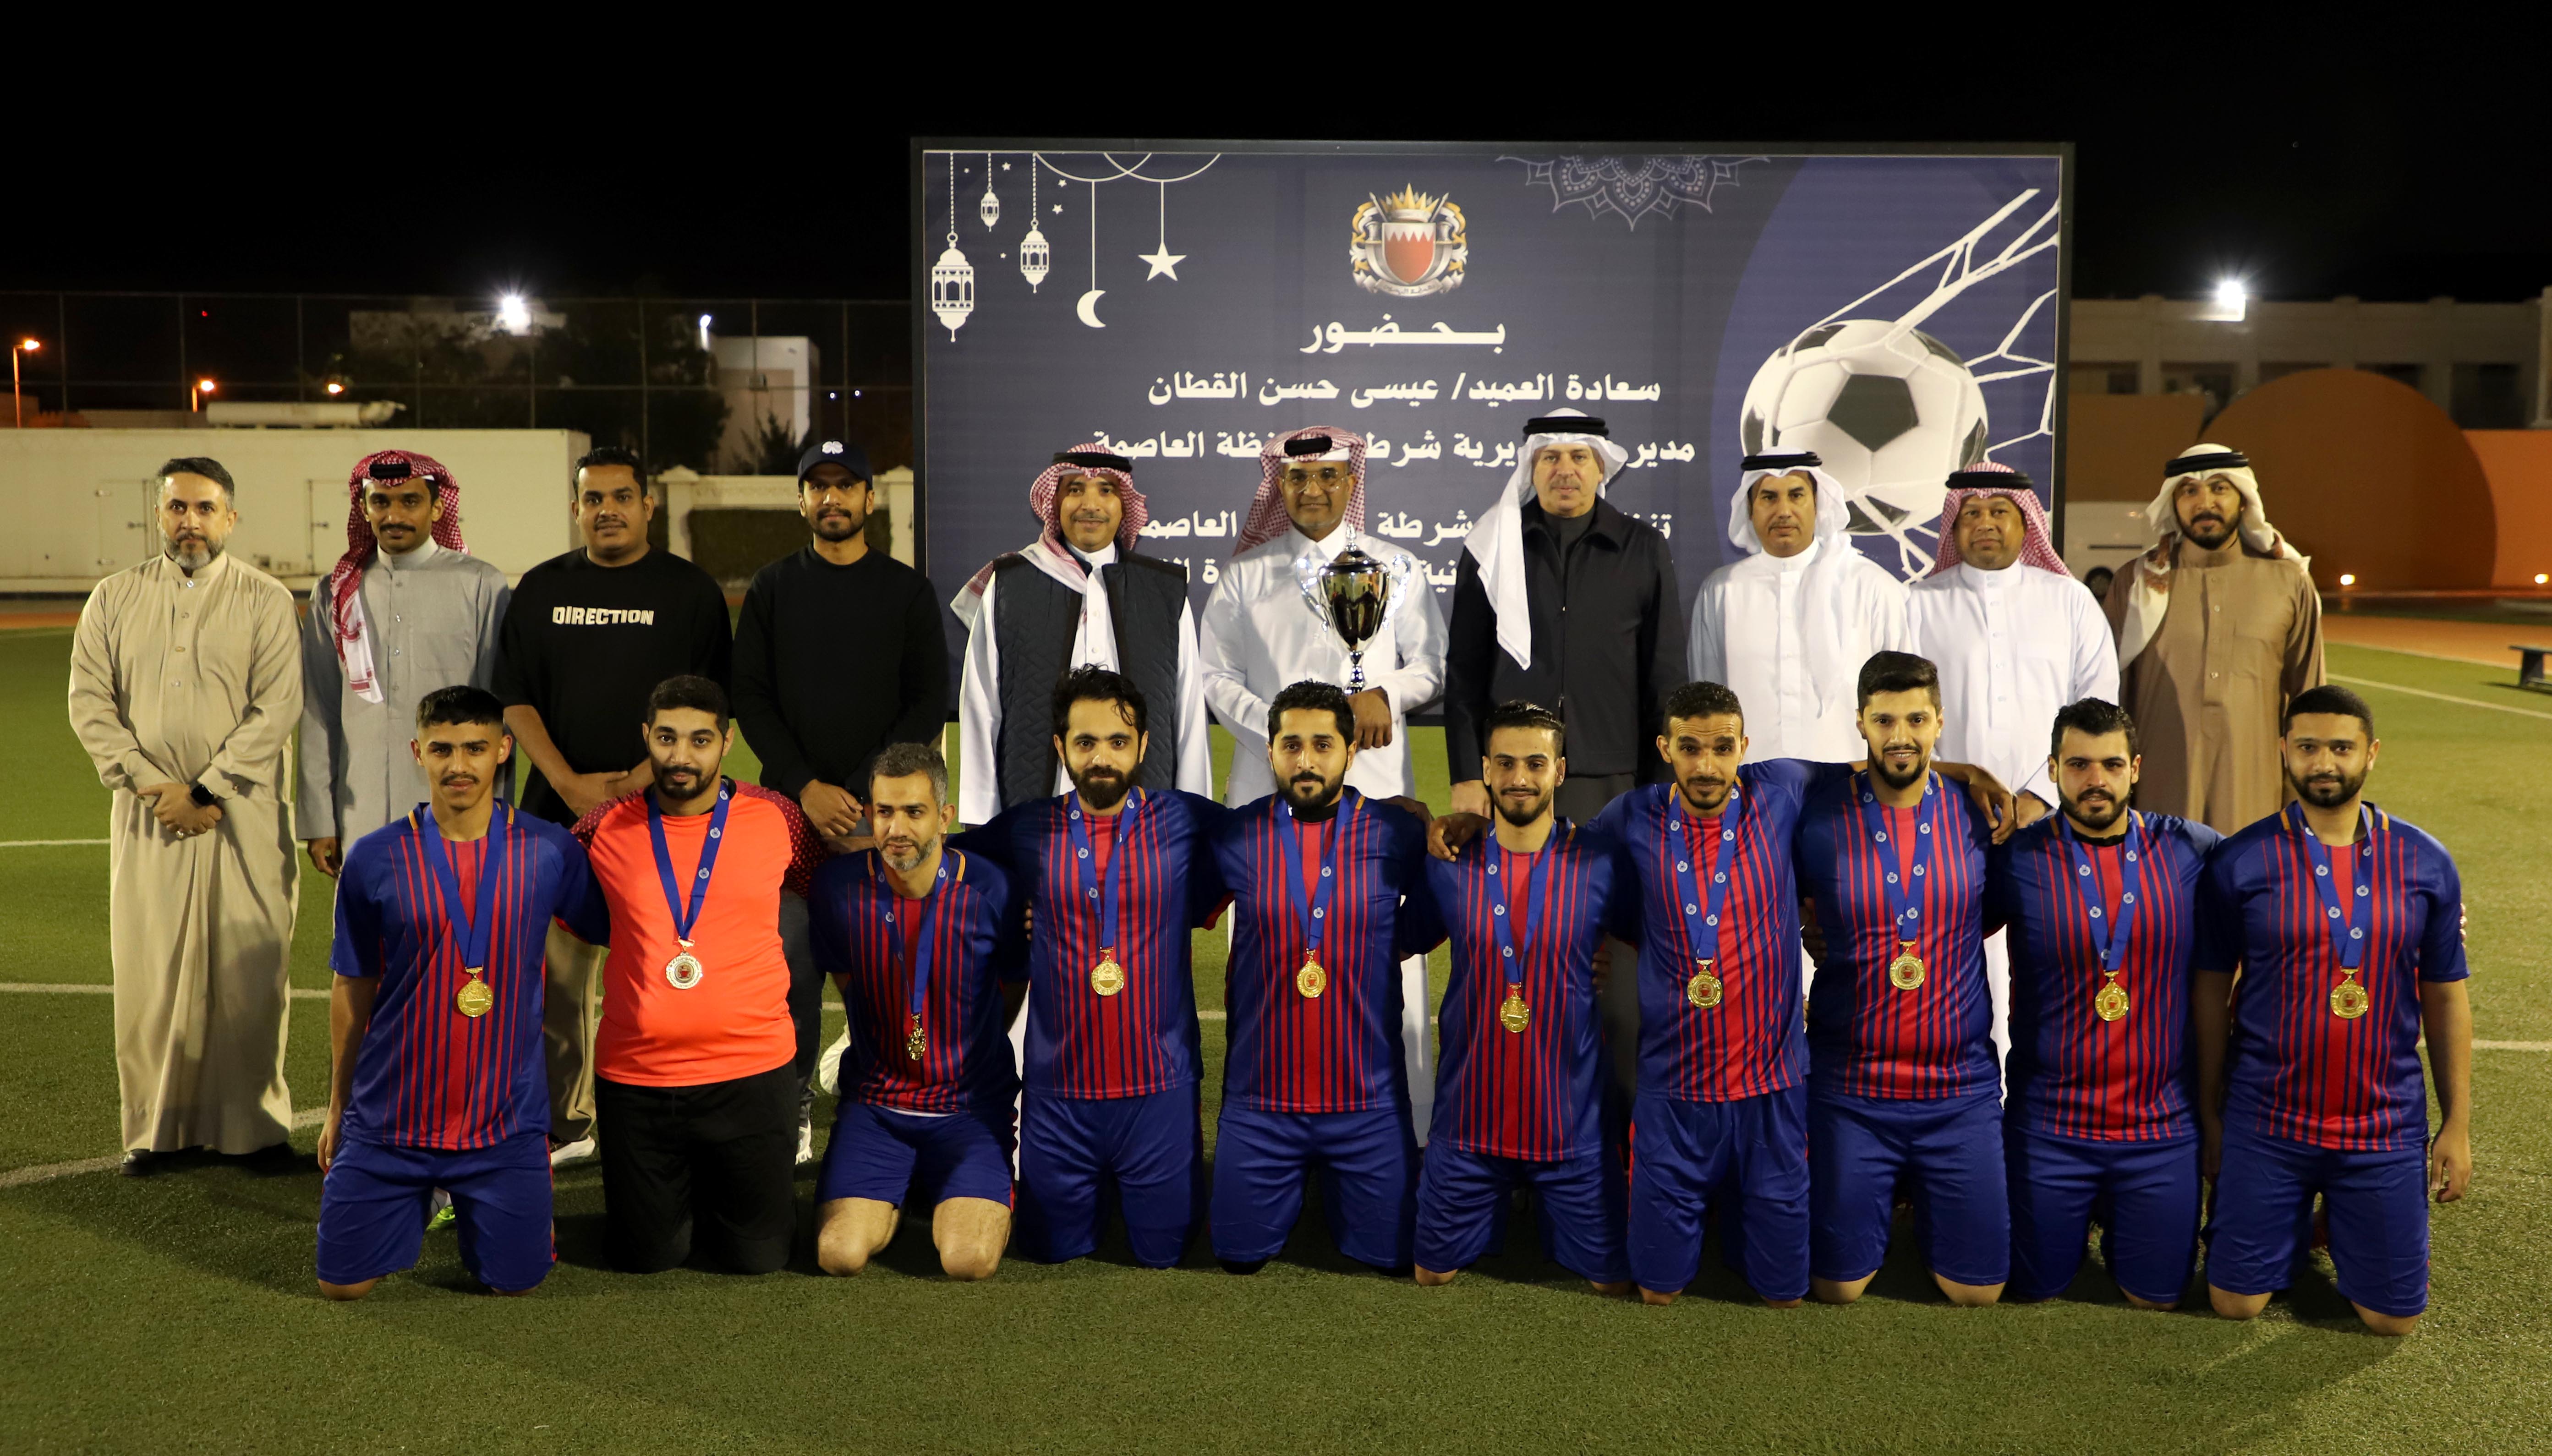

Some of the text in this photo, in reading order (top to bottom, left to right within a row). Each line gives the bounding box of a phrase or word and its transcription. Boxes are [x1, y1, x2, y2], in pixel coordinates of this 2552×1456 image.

[1300, 313, 1506, 354] بحضور
[1148, 371, 1661, 408] سعادة العميد/ عيسى حسن القطان
[1365, 430, 1441, 467] شرط
[1626, 440, 1695, 469] مدير
[1138, 509, 1474, 547] شرطة العاصم
[552, 606, 655, 626] DIRECTION
